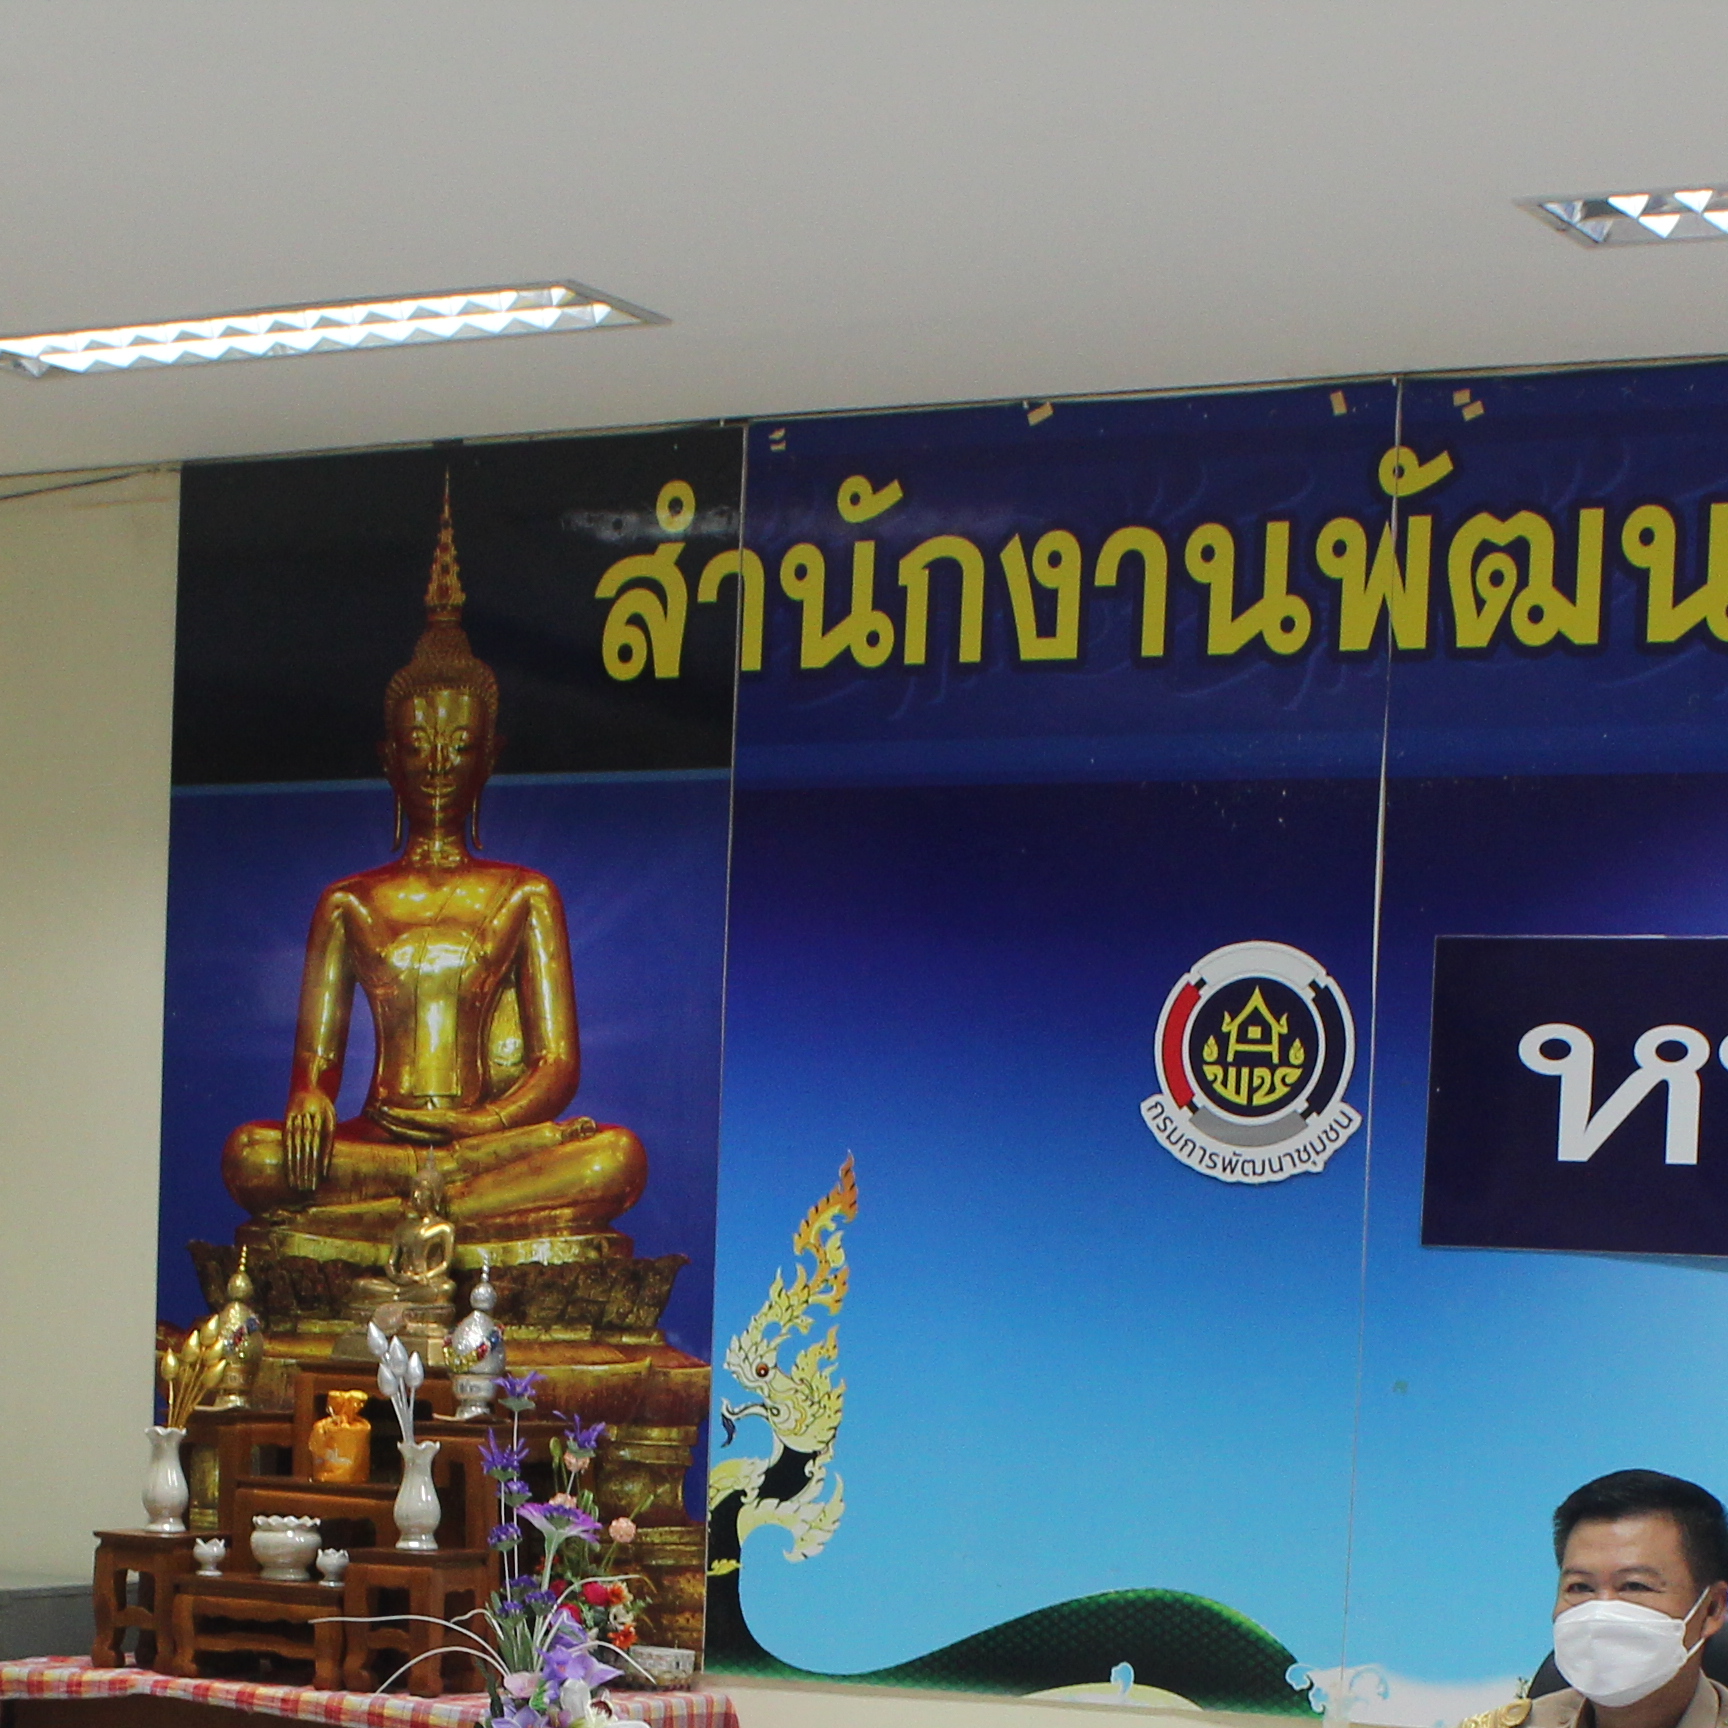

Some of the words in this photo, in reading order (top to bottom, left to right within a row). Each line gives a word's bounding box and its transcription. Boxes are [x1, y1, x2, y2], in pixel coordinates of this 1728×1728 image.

[1145, 1100, 1354, 1178] กรมการพัฒนาชุมชน
